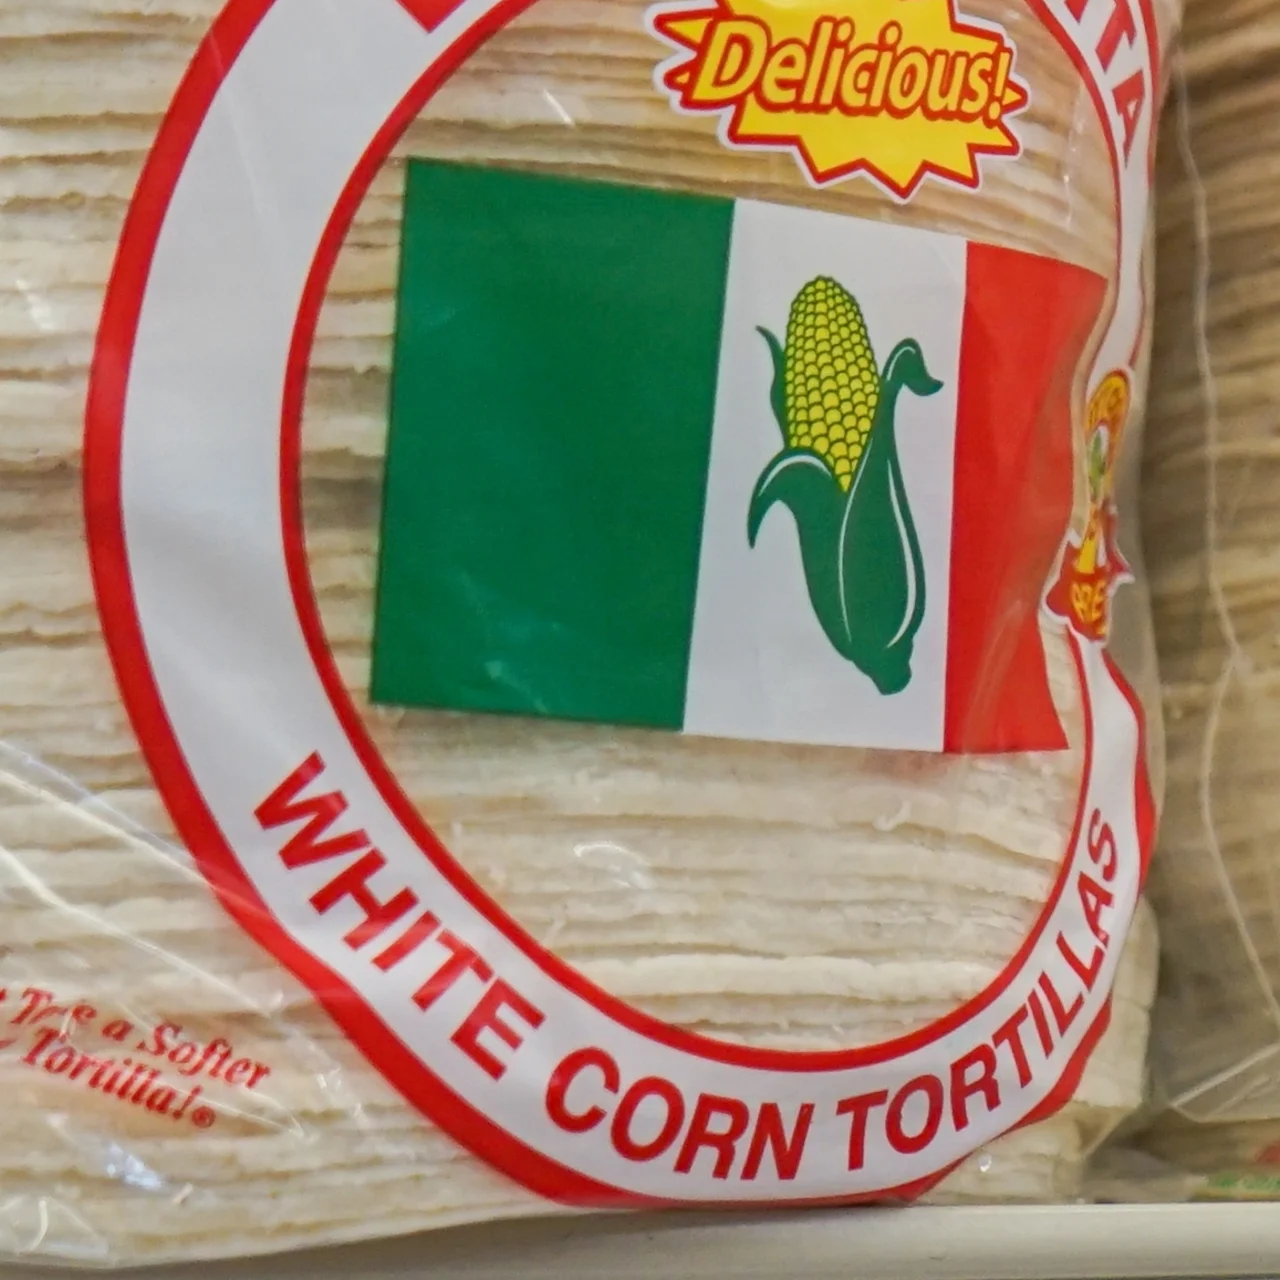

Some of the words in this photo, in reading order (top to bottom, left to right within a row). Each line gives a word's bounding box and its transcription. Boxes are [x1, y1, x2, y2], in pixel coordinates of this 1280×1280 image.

[688, 14, 1010, 125] Delicious!
[253, 751, 546, 1082] WHITE
[545, 1045, 812, 1182] CORN
[836, 808, 1118, 1172] TORTILLAS
[102, 1019, 135, 1042] a
[136, 1021, 272, 1090] Softer
